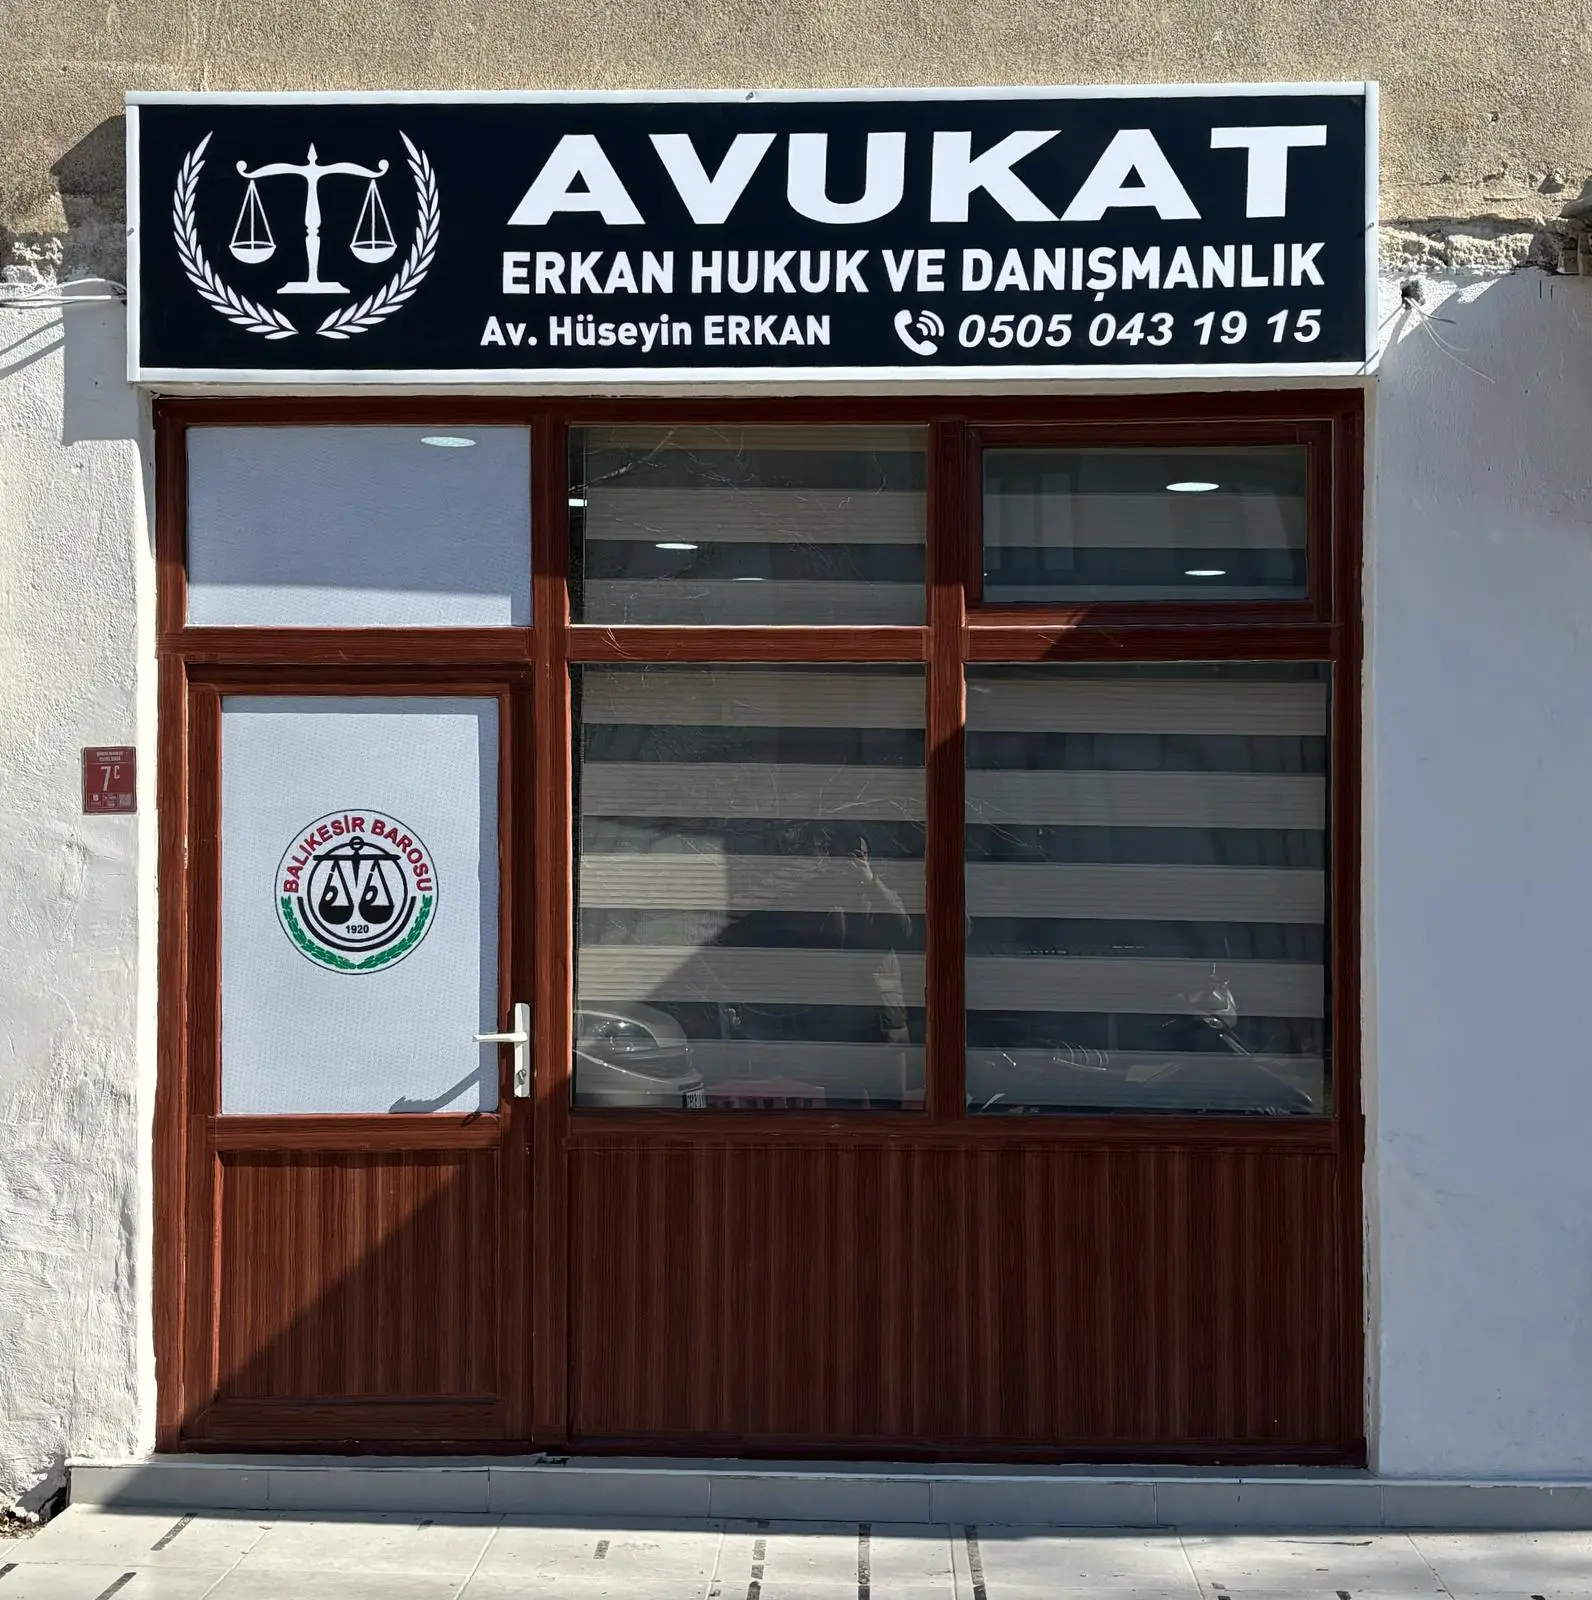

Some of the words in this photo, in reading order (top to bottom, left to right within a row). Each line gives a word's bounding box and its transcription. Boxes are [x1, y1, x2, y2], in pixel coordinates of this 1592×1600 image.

[506, 124, 1328, 226] AVUKAT
[502, 249, 674, 295] ERKAN
[691, 248, 870, 294] HUKUK
[881, 248, 946, 293] VE
[961, 242, 1326, 302] DANIŞMANLIK
[480, 315, 538, 348] Av.
[549, 313, 692, 353] Hüseyin
[704, 314, 831, 346] ERKAN
[958, 313, 1073, 349] 0505
[1088, 311, 1174, 347] 043
[1193, 310, 1248, 346] 19
[1266, 308, 1322, 343] 15
[370, 819, 433, 892] BAROSU
[345, 924, 369, 934] 1920
